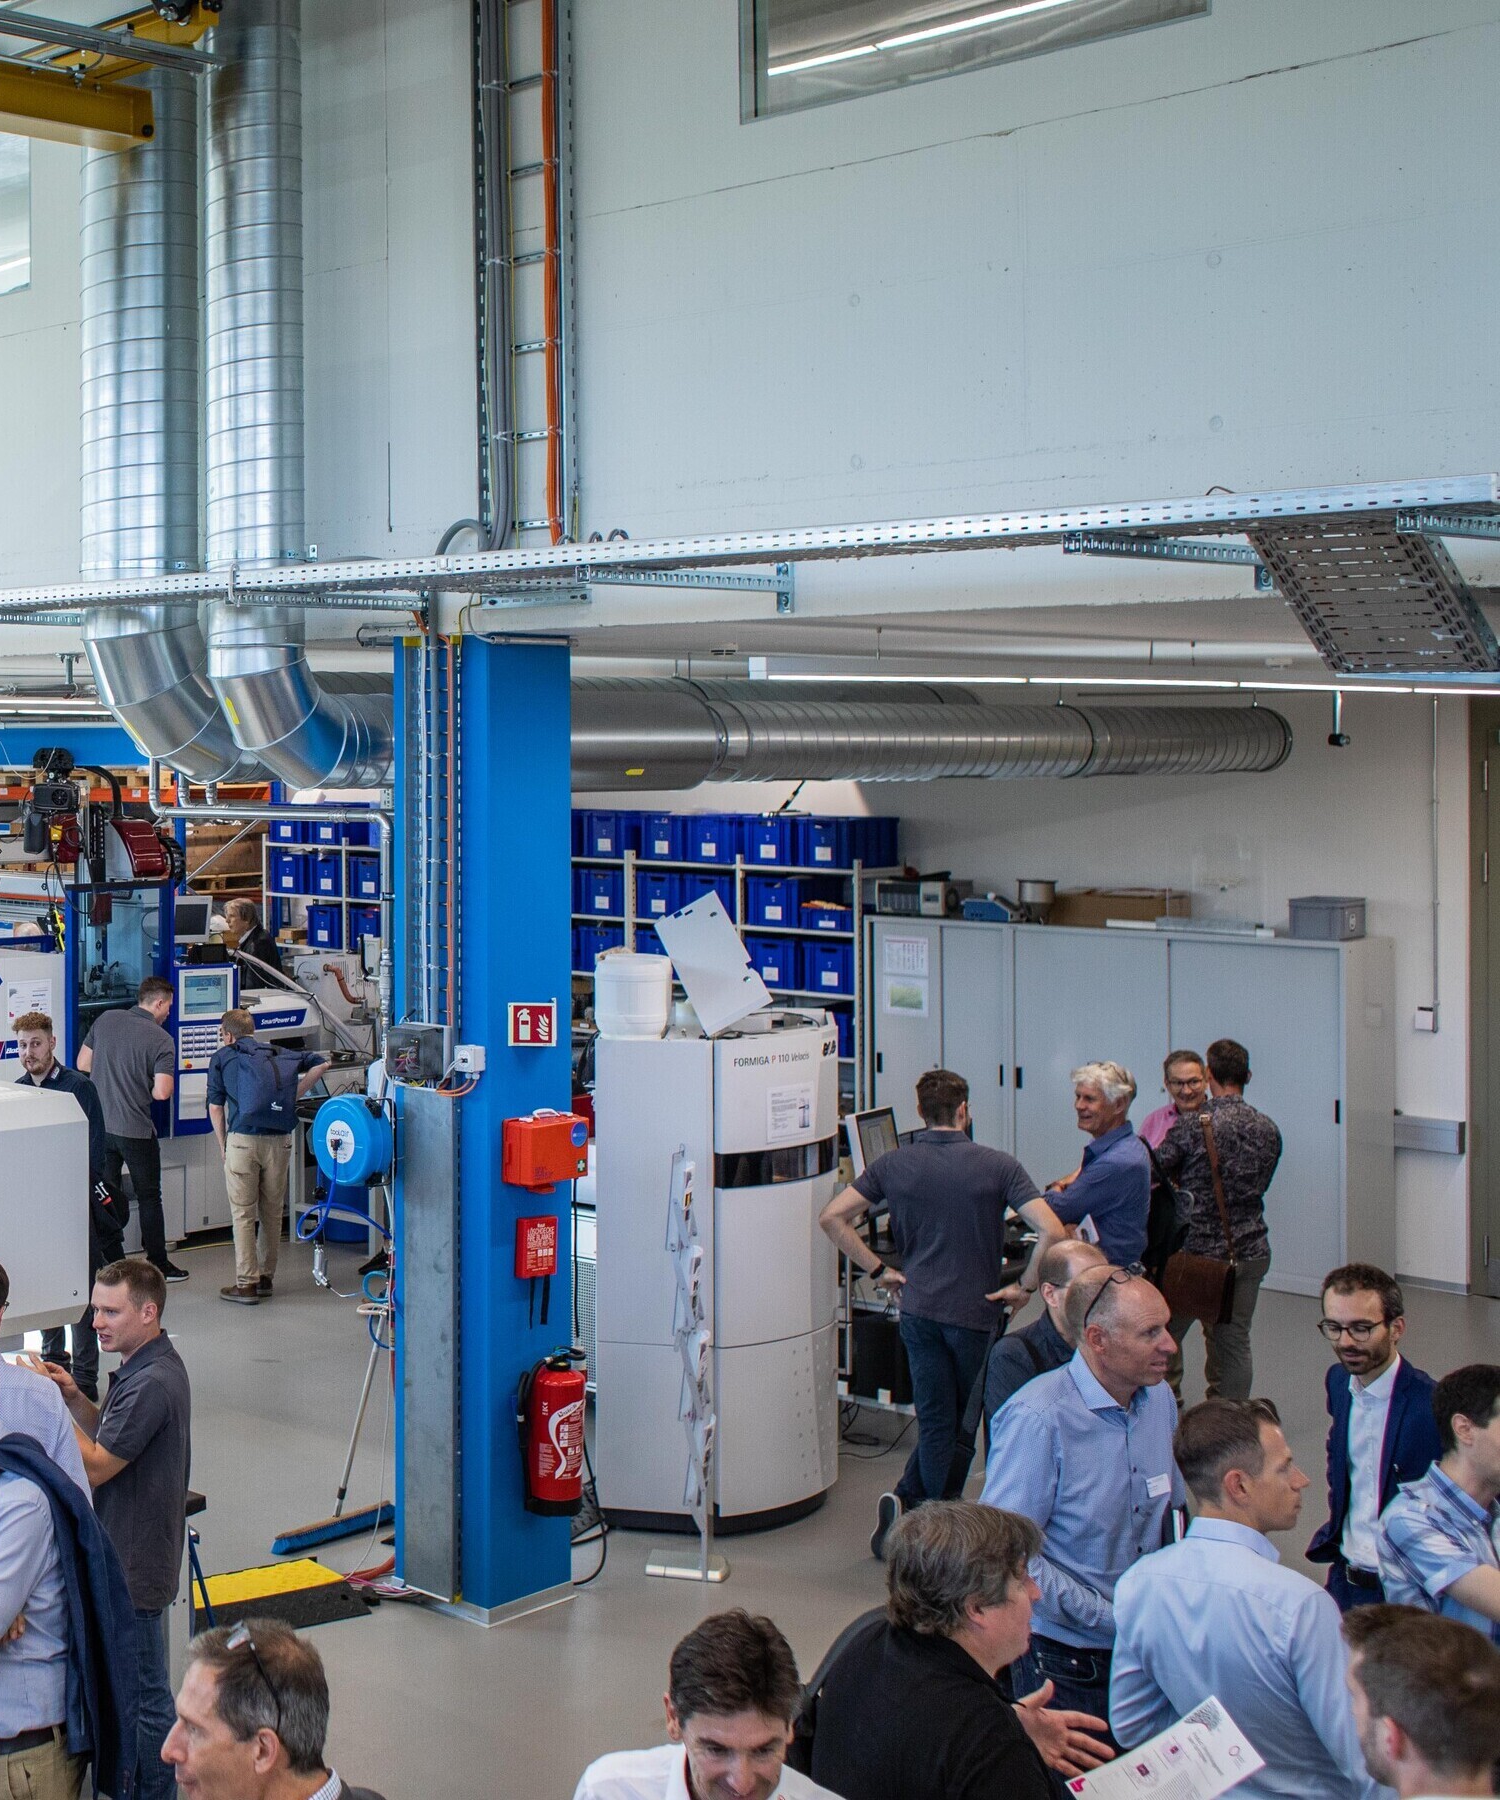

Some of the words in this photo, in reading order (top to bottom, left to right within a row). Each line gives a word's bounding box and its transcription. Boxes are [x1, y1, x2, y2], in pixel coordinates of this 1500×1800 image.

[260, 1016, 289, 1026] SmartPower
[733, 1056, 770, 1068] FORMIGA
[771, 1055, 777, 1064] P
[778, 1053, 790, 1063] 110
[791, 1052, 810, 1062] Velocis
